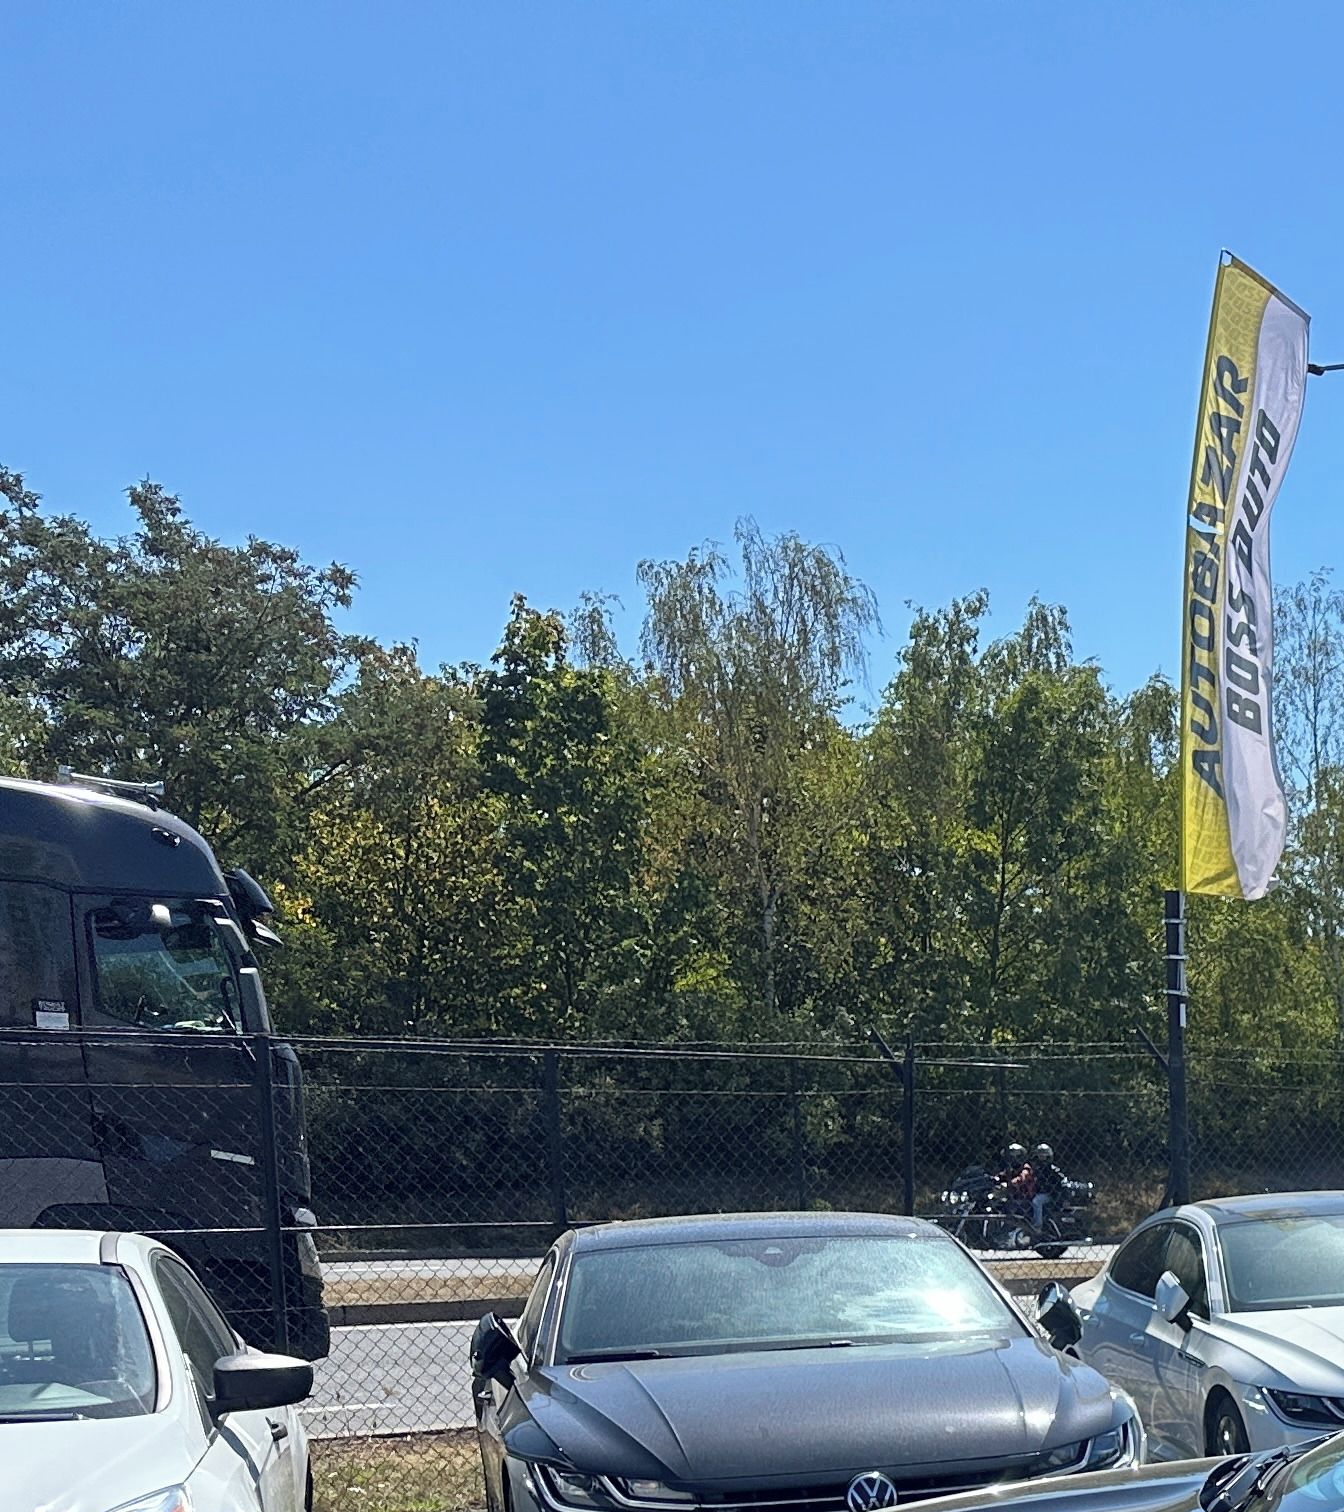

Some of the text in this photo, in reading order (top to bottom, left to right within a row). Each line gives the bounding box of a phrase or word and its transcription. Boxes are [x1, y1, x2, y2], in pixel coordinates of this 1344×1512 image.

[1188, 354, 1250, 800] AUTOBAZAR
[1226, 408, 1281, 736] BOSS AUTO
